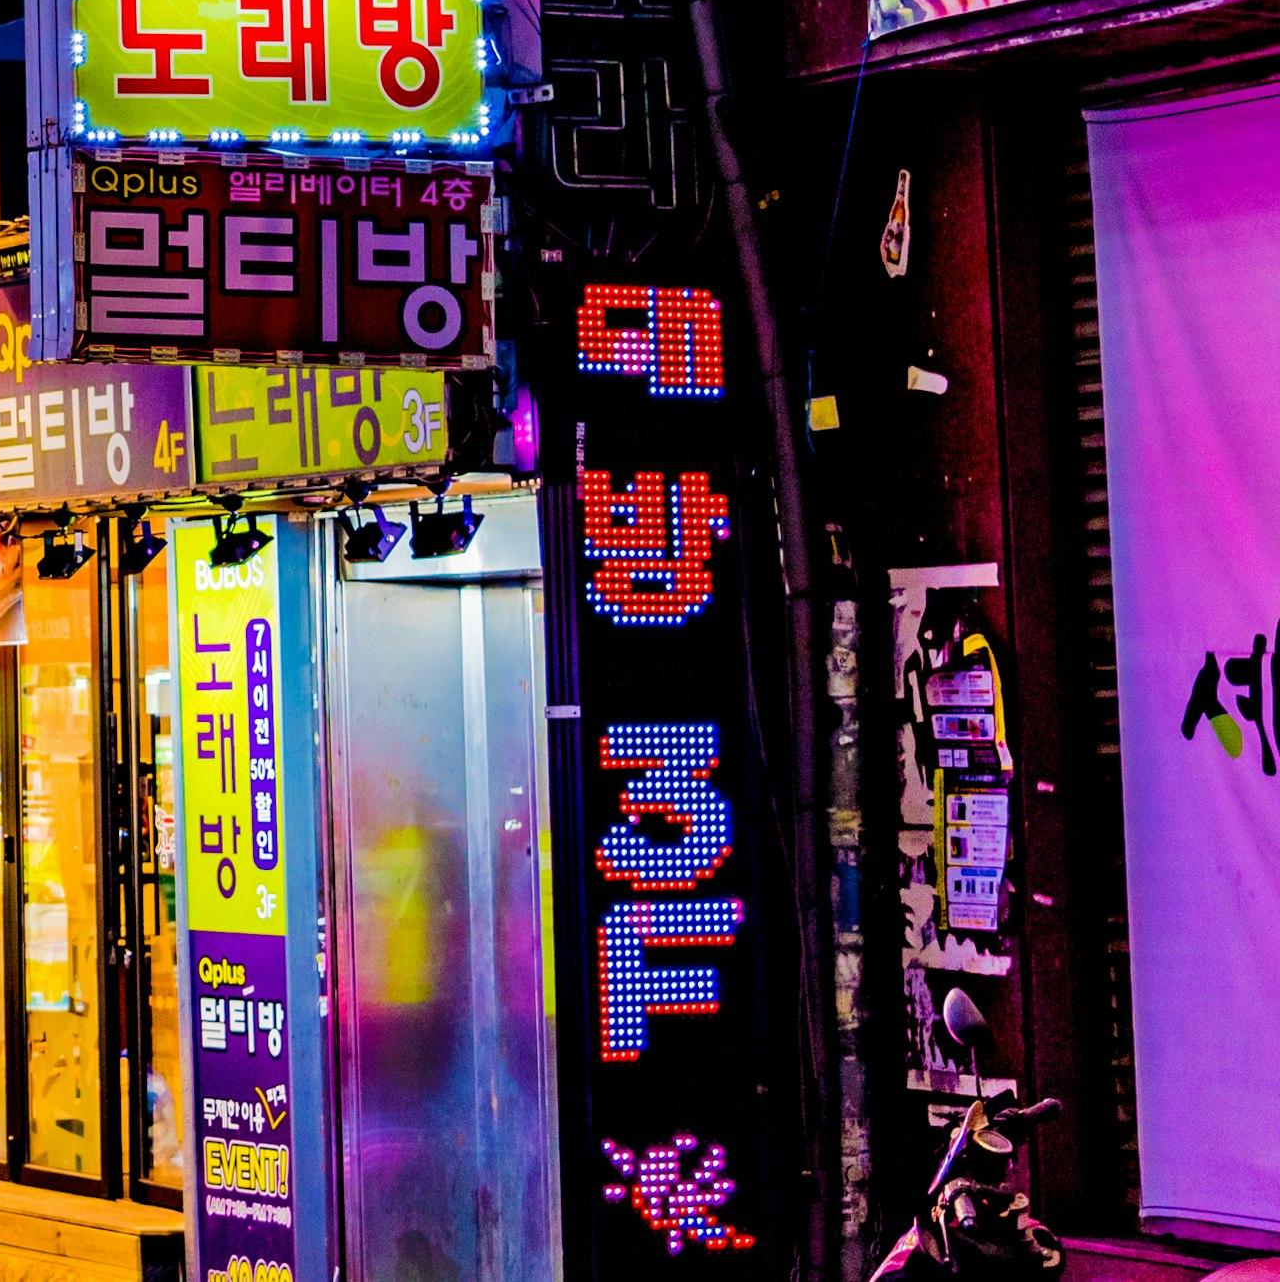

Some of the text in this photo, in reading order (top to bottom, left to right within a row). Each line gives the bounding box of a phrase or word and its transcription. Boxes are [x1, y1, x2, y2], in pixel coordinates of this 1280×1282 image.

[90, 166, 474, 211] Qplus 엘리베이터 4층
[89, 211, 479, 350] 멀티방
[152, 418, 185, 475] 4F
[207, 369, 441, 476] 노래방 3F
[193, 552, 268, 595] BOBOS
[191, 612, 242, 900] 노래방
[249, 758, 276, 862] 50% 할인
[255, 884, 277, 921] 3F
[198, 956, 246, 989] Qplus
[200, 996, 285, 1059] 멀티방
[204, 1137, 289, 1199] EVENT!
